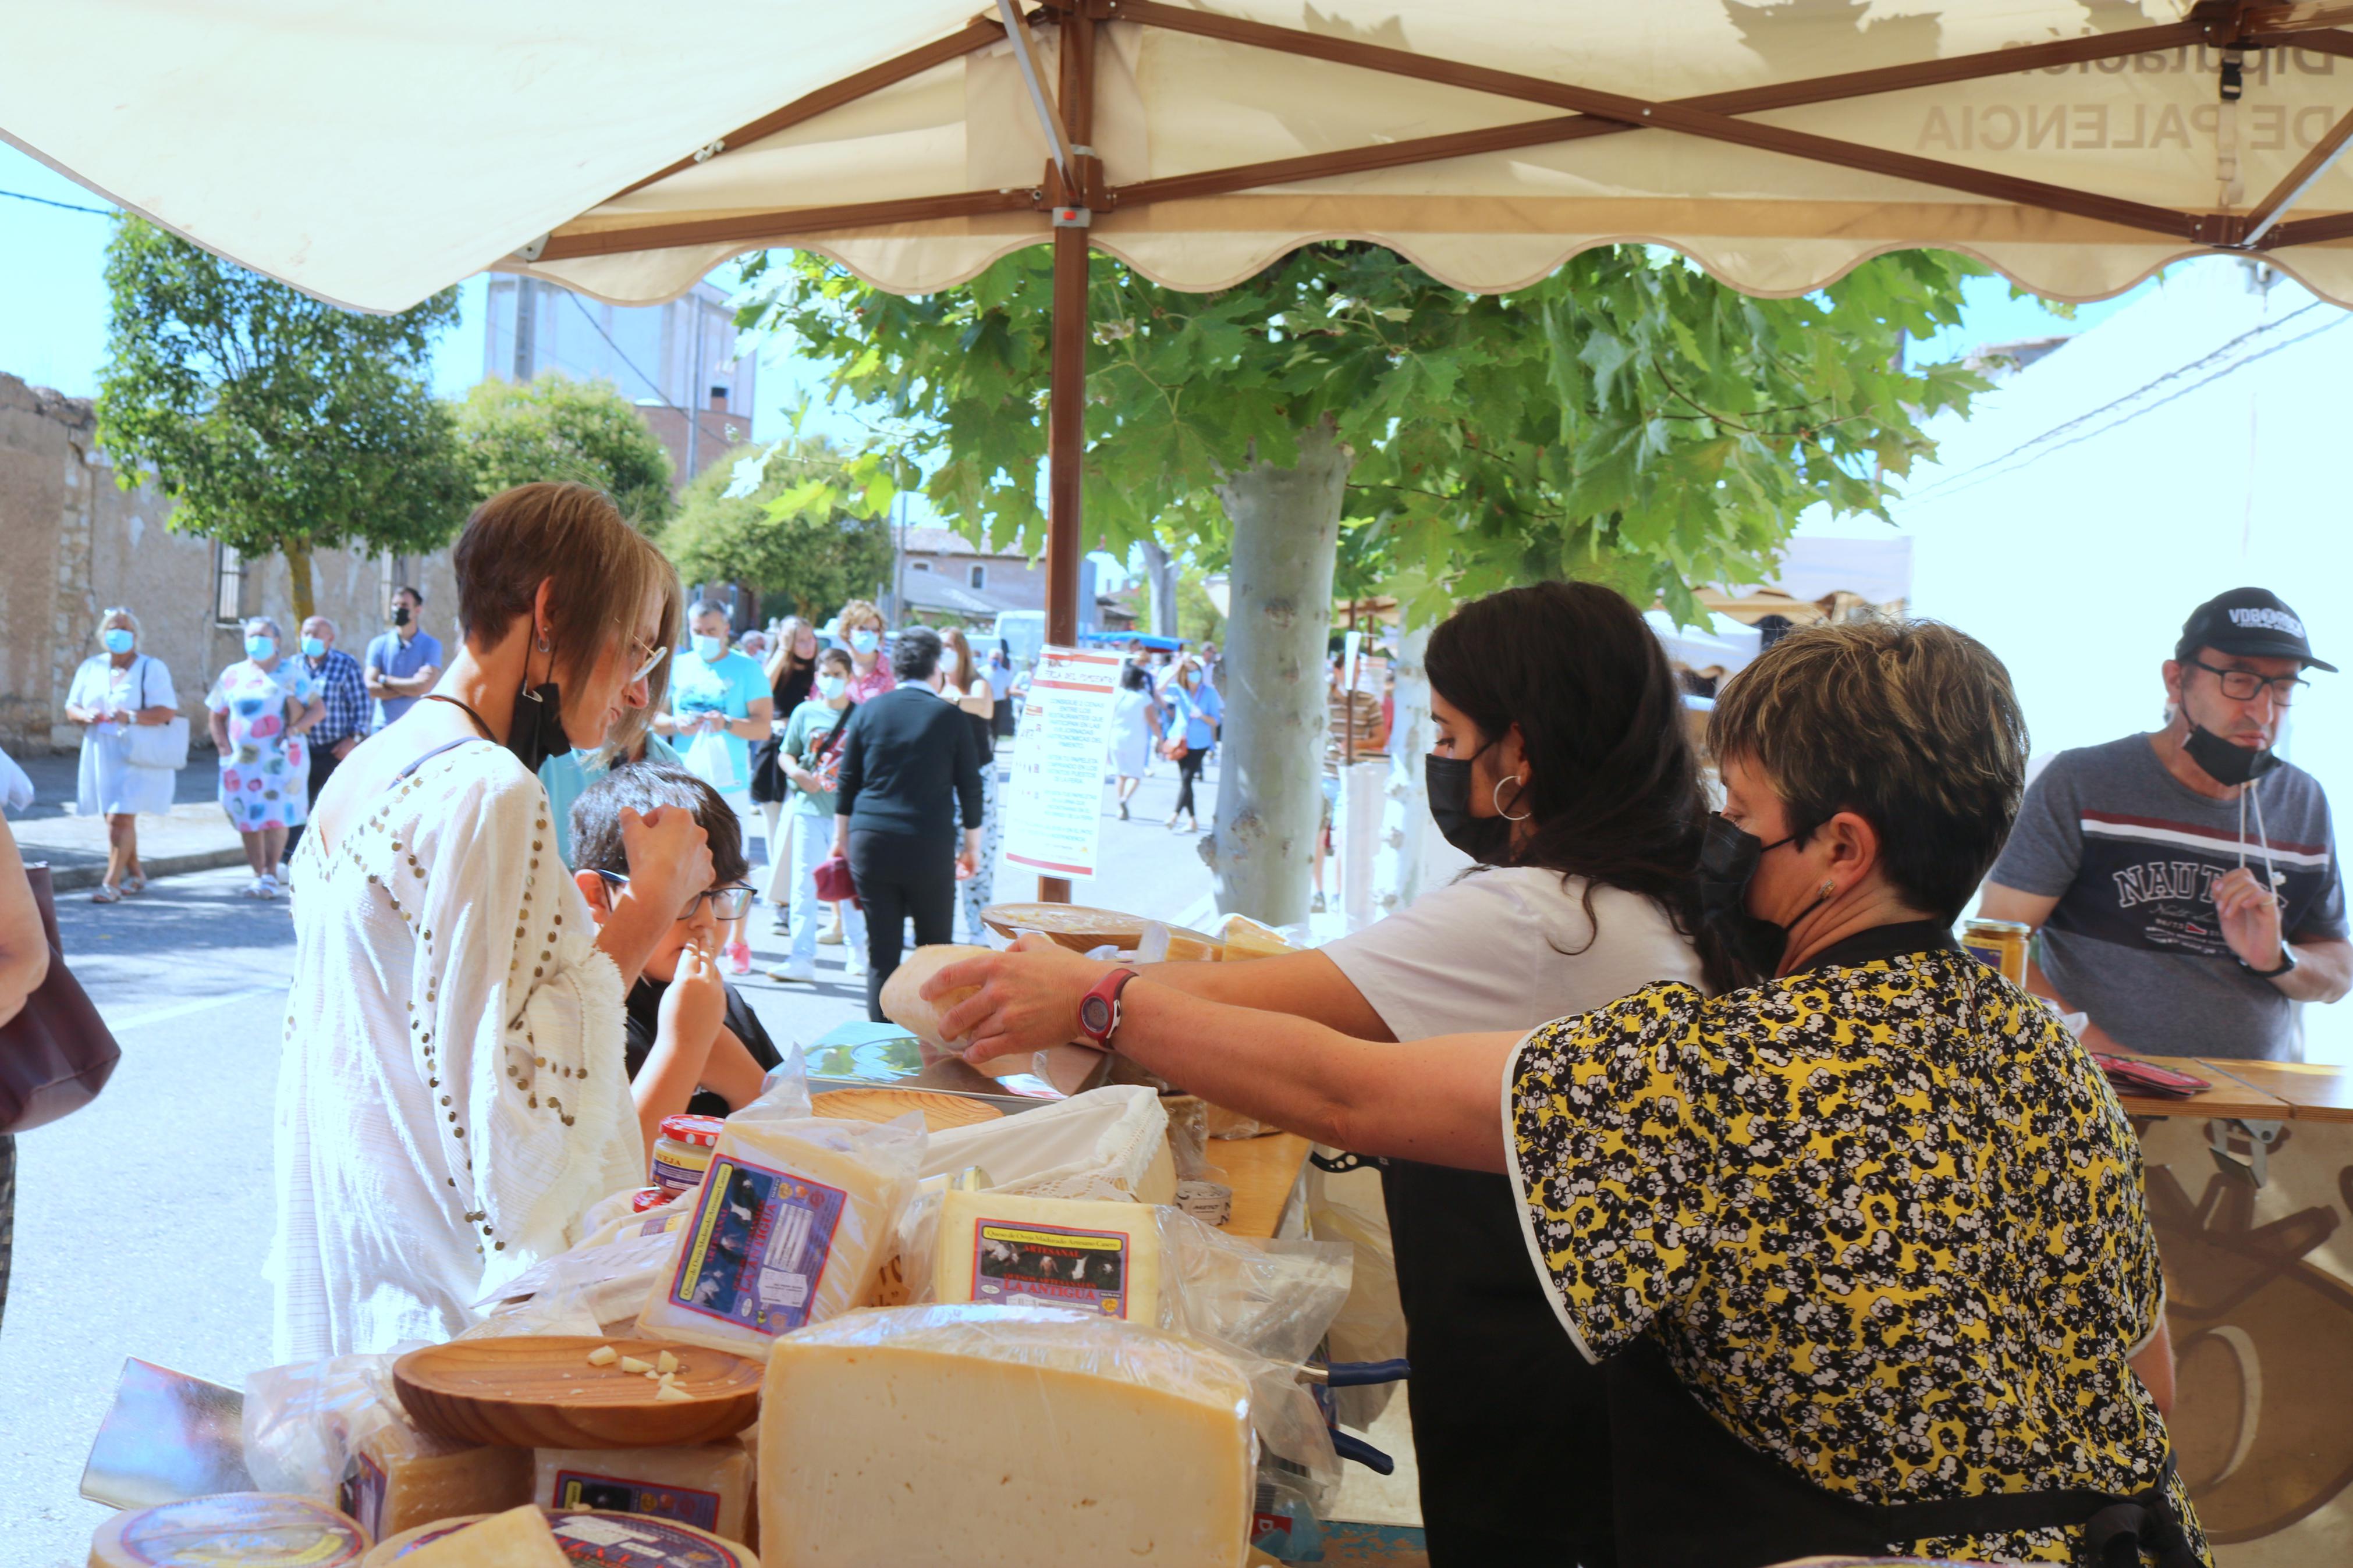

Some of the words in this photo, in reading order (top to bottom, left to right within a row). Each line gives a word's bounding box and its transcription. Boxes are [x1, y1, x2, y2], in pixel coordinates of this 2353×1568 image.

[2113, 861, 2289, 908] NAUT
[717, 1167, 729, 1189] Casero
[708, 1189, 722, 1217] Artesano
[697, 1215, 714, 1249] Madurado
[704, 1206, 730, 1264] ARTESANAL
[745, 1201, 779, 1271] ANTIGUA
[987, 1230, 1007, 1239] Queso
[1017, 1233, 1034, 1242] Oveja
[1035, 1234, 1067, 1245] Madurado
[1068, 1238, 1095, 1246] Artesano
[692, 1248, 704, 1268] Oveja
[1024, 1245, 1080, 1258] ARTESANAL
[689, 1267, 697, 1275] de
[1003, 1273, 1036, 1282] QUESOS
[1038, 1278, 1097, 1289] ARTESANALES
[683, 1275, 695, 1296] Queso
[739, 1271, 755, 1293] LA
[1003, 1279, 1023, 1292] LA
[1028, 1283, 1096, 1300] ANTIGUA
